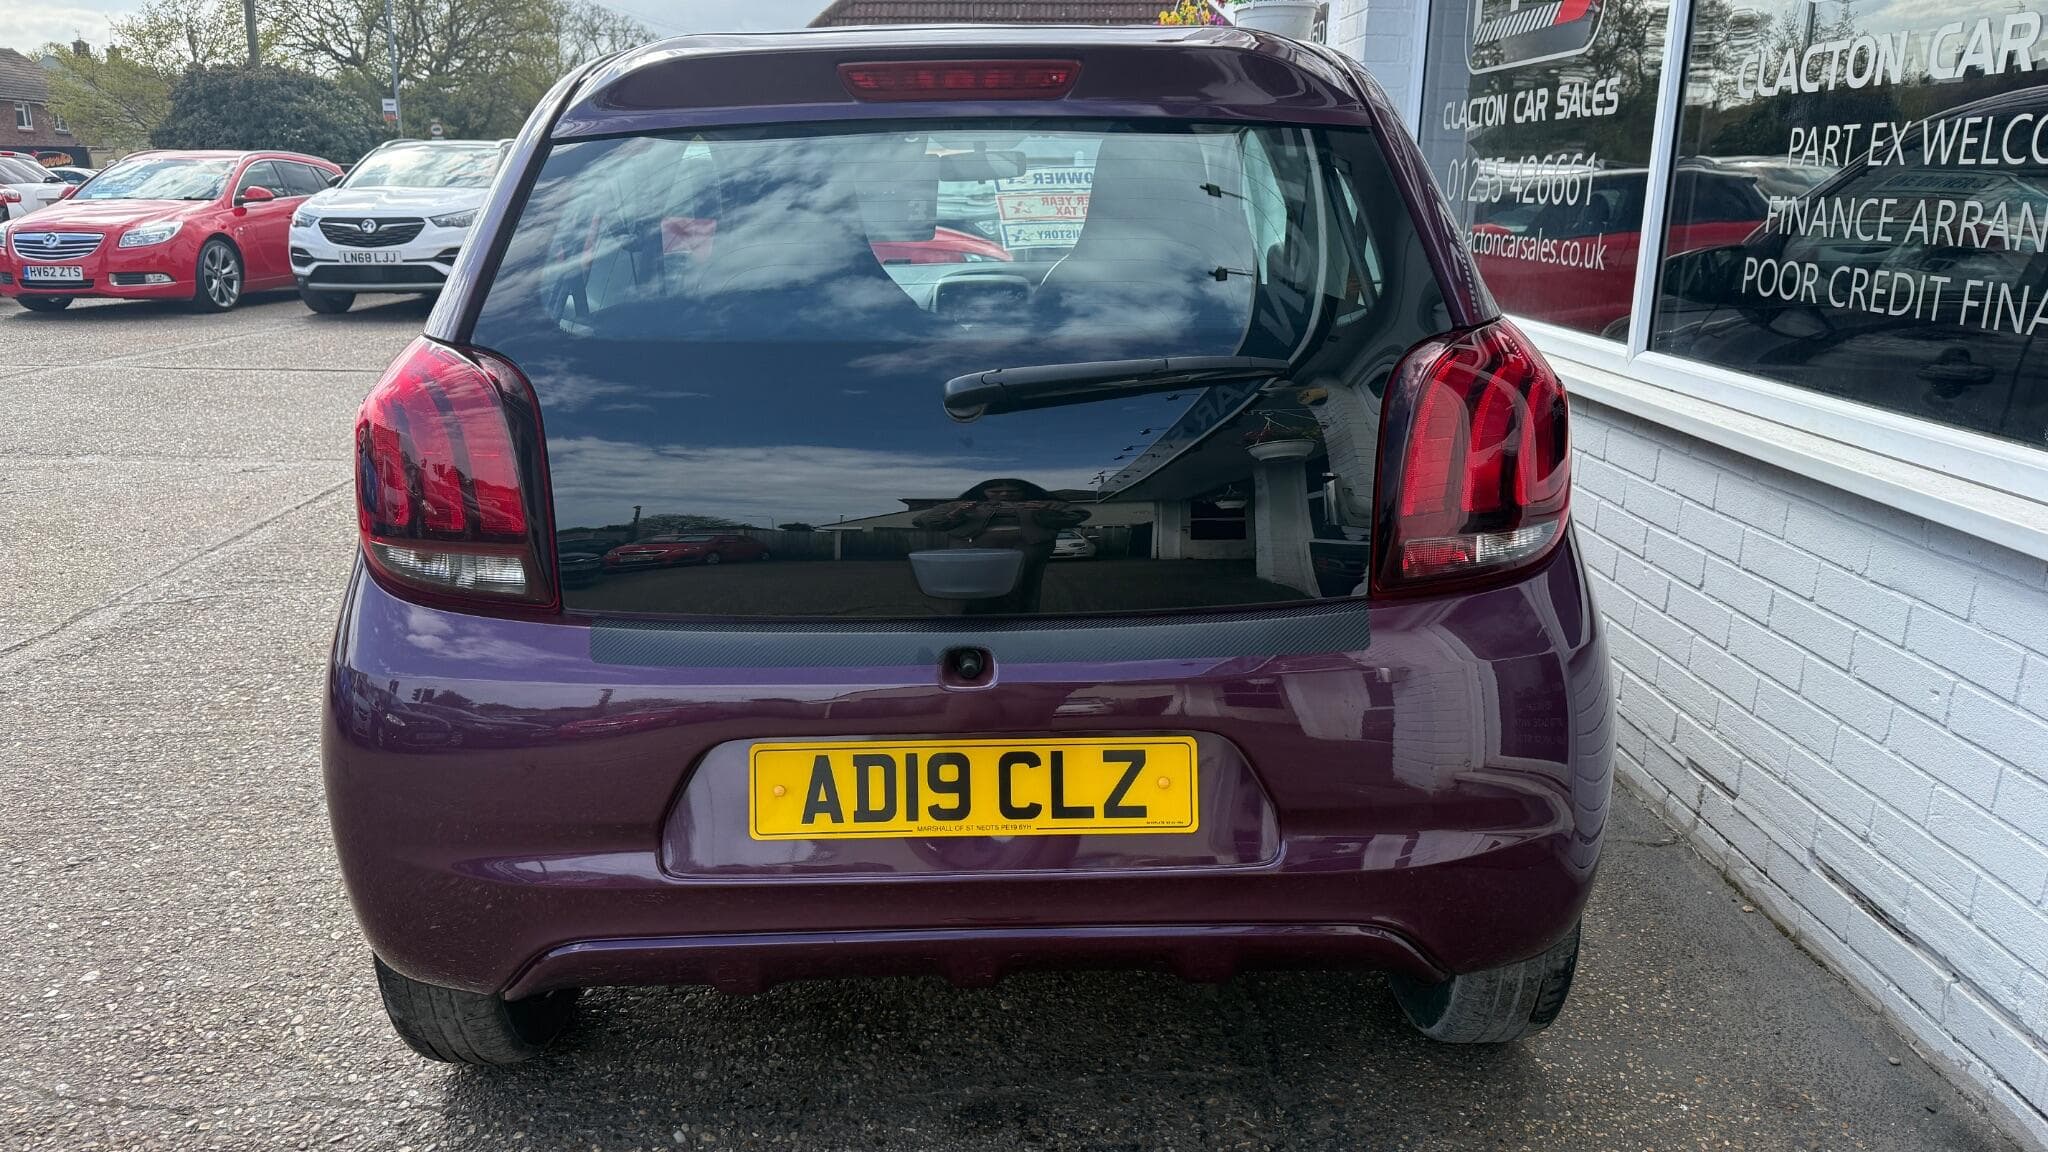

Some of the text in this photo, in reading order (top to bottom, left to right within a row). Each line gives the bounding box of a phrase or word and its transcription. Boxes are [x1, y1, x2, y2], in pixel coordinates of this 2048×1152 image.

[1738, 11, 2041, 98] CLACTON CAR
[1443, 75, 1621, 130] CLACTON CAR SALES
[1787, 123, 1862, 168] PART
[1867, 120, 1912, 166] EX
[1446, 152, 1597, 206] 01255 426661
[1462, 221, 1608, 271] lactoncarsales.co.uk
[1765, 195, 2048, 253] FINANCE ARRAN
[29, 266, 81, 277] HV62 ZTS
[343, 252, 396, 263] LN68 LJJ
[1741, 257, 1819, 304] POOR
[1828, 266, 1951, 321] CREDIT
[801, 750, 1148, 824] AD19 CLZ
